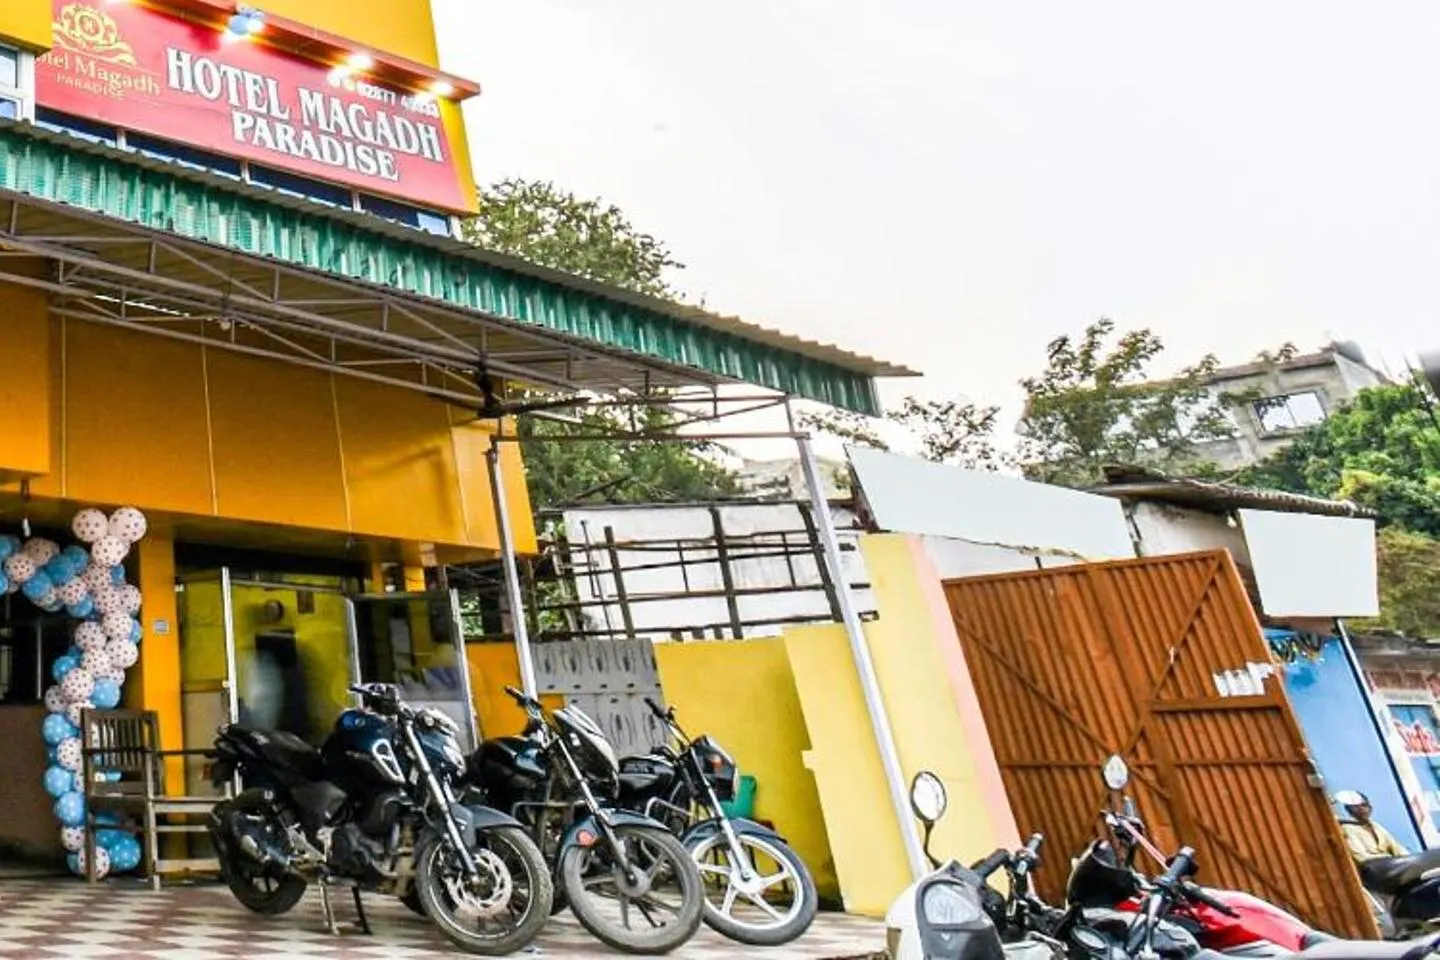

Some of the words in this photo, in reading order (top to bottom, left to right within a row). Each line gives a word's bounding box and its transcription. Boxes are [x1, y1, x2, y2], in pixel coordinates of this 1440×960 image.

[35, 49, 70, 70] otel
[74, 54, 161, 96] Magadh
[166, 47, 292, 120] HOTEL
[297, 87, 445, 163] MAGADH
[232, 110, 400, 182] PARADISE
